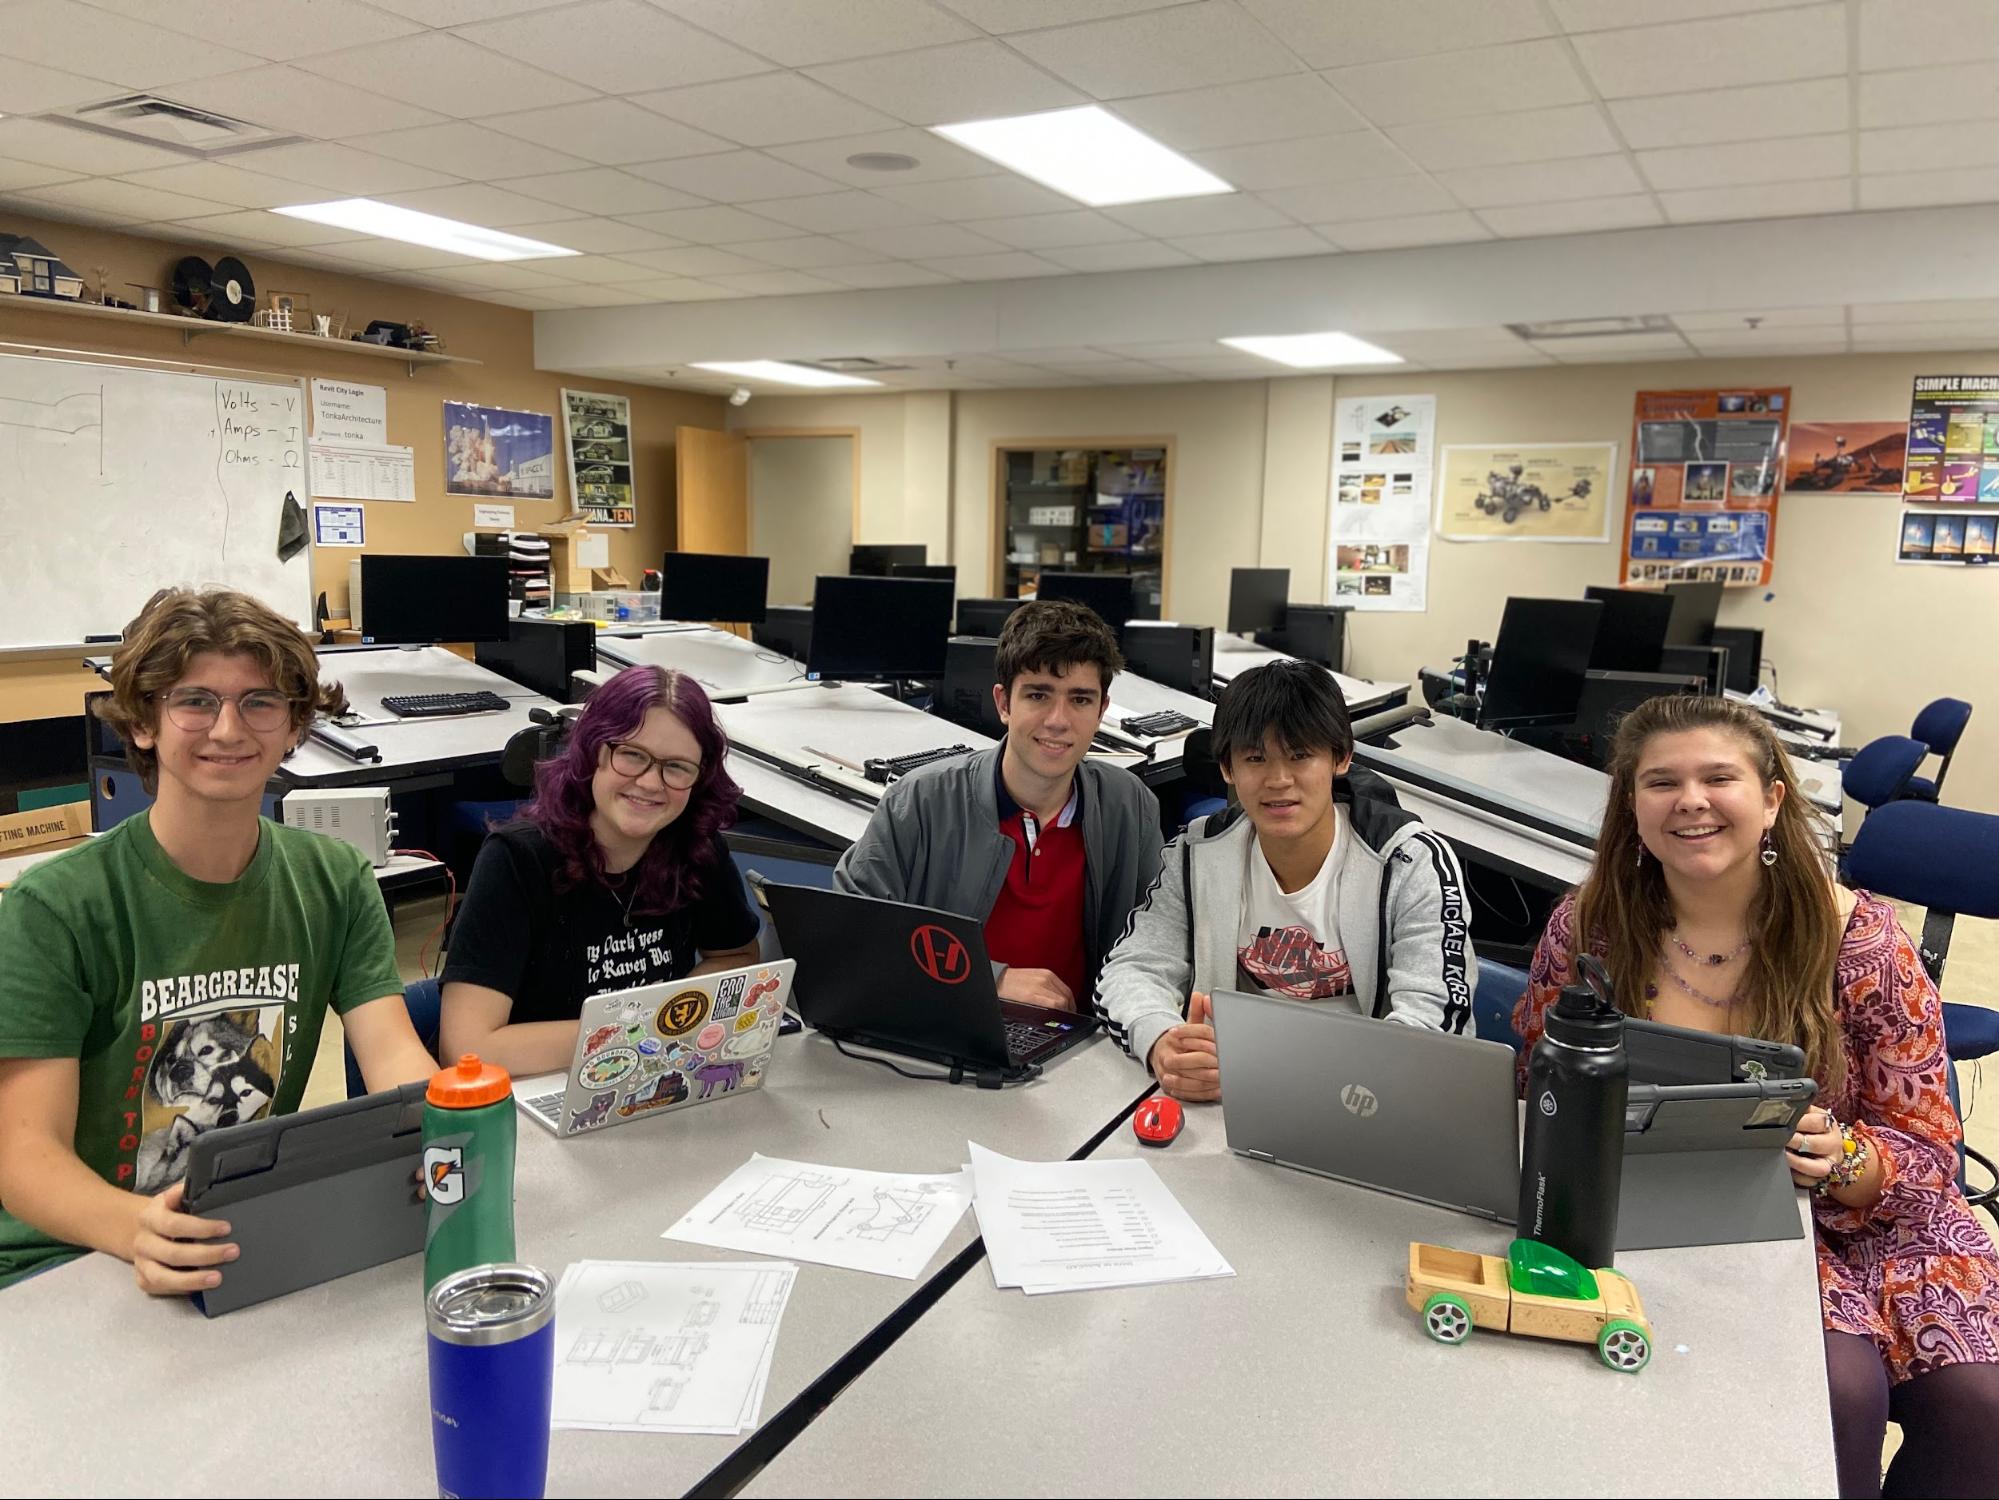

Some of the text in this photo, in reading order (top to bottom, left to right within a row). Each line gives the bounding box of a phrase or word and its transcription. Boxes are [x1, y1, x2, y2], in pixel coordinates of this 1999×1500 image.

[320, 385, 364, 397] Revit City Login
[1915, 377, 1999, 391] SIMPLE MACH
[222, 389, 259, 413] Volts
[286, 397, 296, 412] V
[321, 411, 382, 425] TonkaArchitecture
[224, 417, 261, 442] Amps
[344, 431, 363, 440] tonka
[225, 449, 261, 466] Ohms
[26, 820, 66, 838] MACHINE
[141, 963, 300, 1022] BEARGREASE
[1343, 1084, 1376, 1118] hp
[424, 1146, 465, 1205] G
[1533, 1171, 1546, 1236] ThermoFlask
